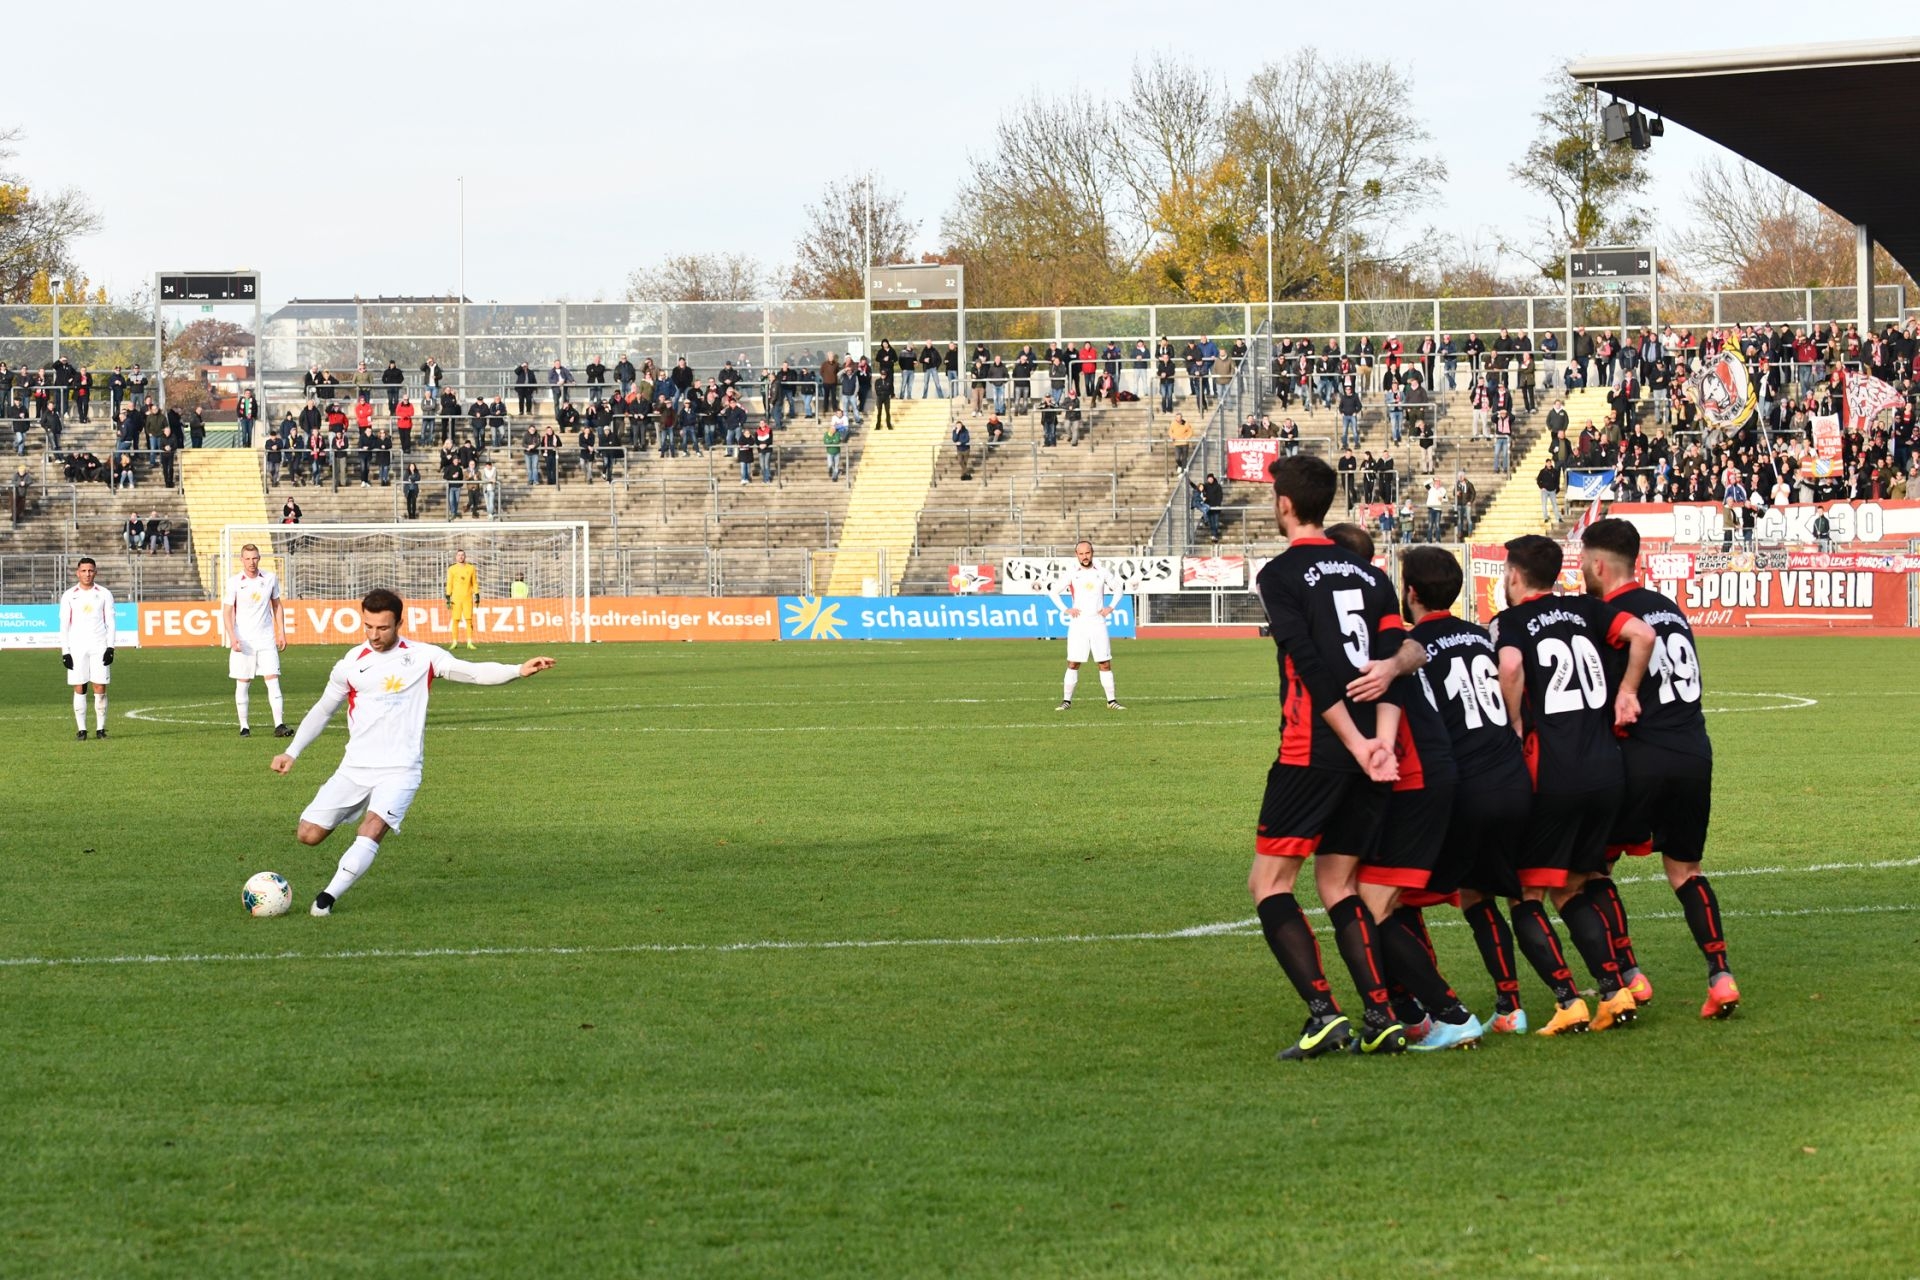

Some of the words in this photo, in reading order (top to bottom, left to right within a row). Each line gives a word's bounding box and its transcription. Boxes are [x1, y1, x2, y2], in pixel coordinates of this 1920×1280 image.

[1574, 262, 1583, 270] 31
[1638, 260, 1648, 268] 30
[164, 285, 174, 293] 34
[243, 284, 253, 292] 33
[945, 279, 955, 287] 32
[1673, 505, 1818, 543] BLCK
[1828, 503, 1884, 543] 30
[1304, 567, 1320, 587] SC
[1315, 561, 1376, 587] Waldgirmes
[1686, 570, 1772, 608] SPORT
[1780, 570, 1874, 608] VEREIN
[306, 608, 367, 633] VO
[531, 612, 564, 627] Die
[707, 610, 771, 626] Kassel
[860, 603, 1038, 627] schauinsland
[1527, 618, 1540, 636] SC
[1332, 588, 1370, 669] 5
[1537, 634, 1607, 715] 20
[1648, 633, 1701, 704] 19
[1444, 654, 1507, 729] 16
